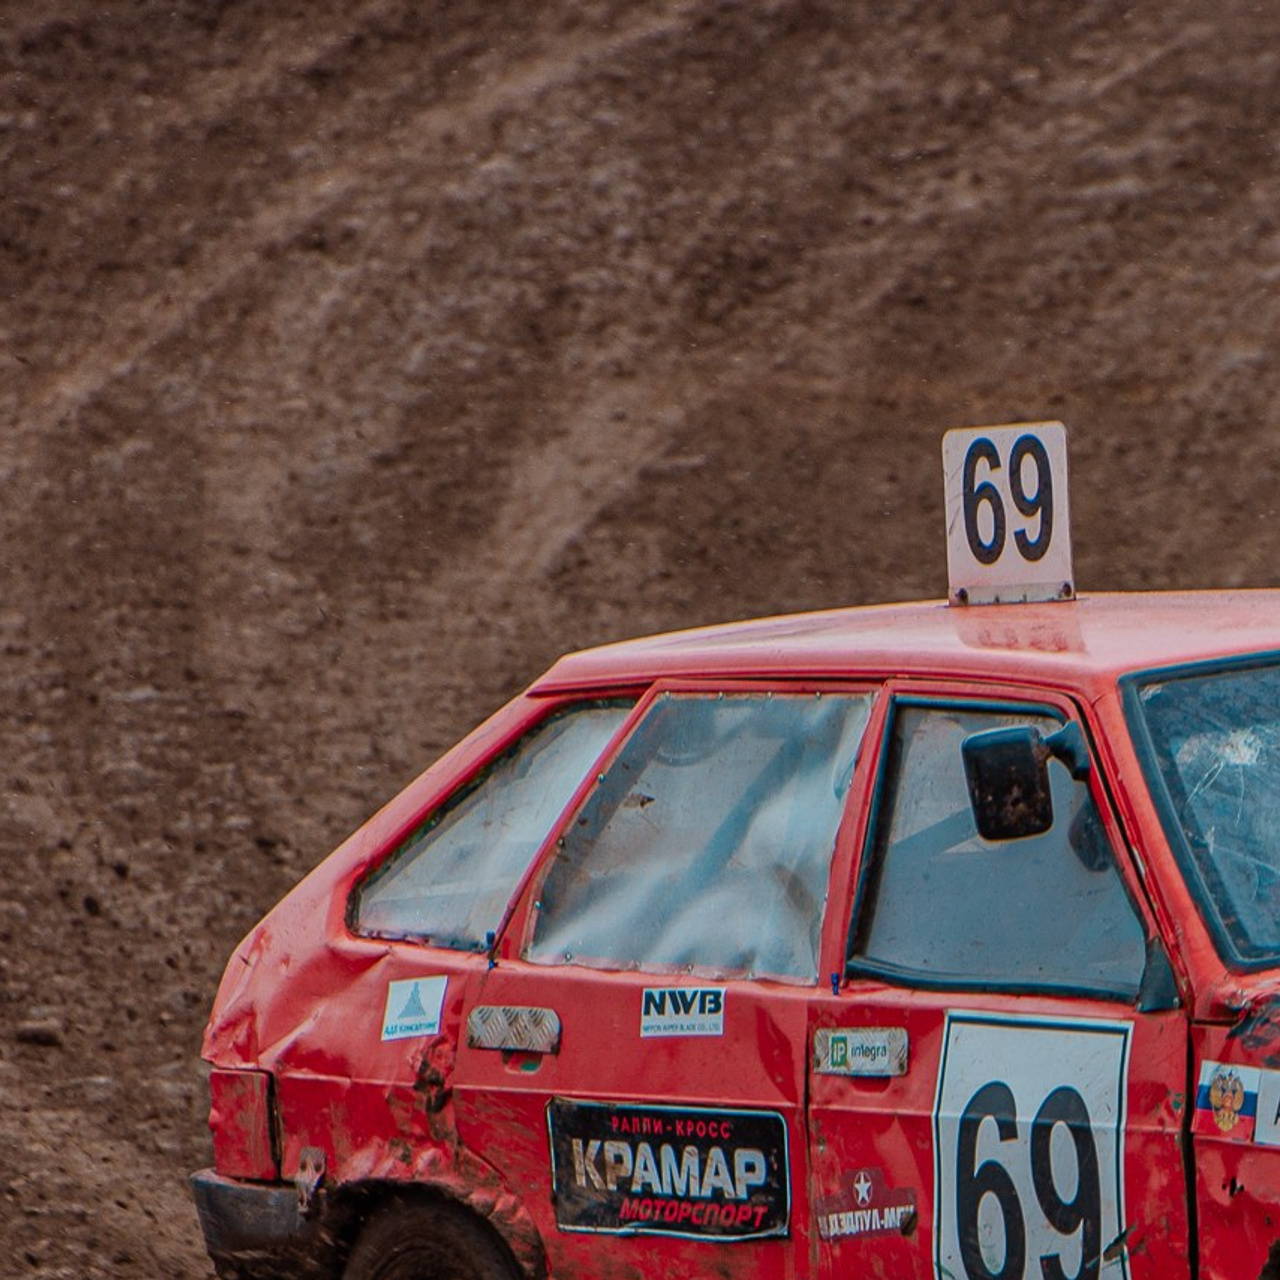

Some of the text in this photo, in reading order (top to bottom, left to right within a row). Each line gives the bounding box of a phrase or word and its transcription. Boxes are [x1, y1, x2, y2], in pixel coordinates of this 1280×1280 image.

[963, 433, 1053, 566] 69
[643, 989, 722, 1016] NWB
[851, 1043, 887, 1061] integra
[572, 1138, 767, 1200] КРАМАР
[619, 1198, 768, 1228] МОТОРСПОРТ
